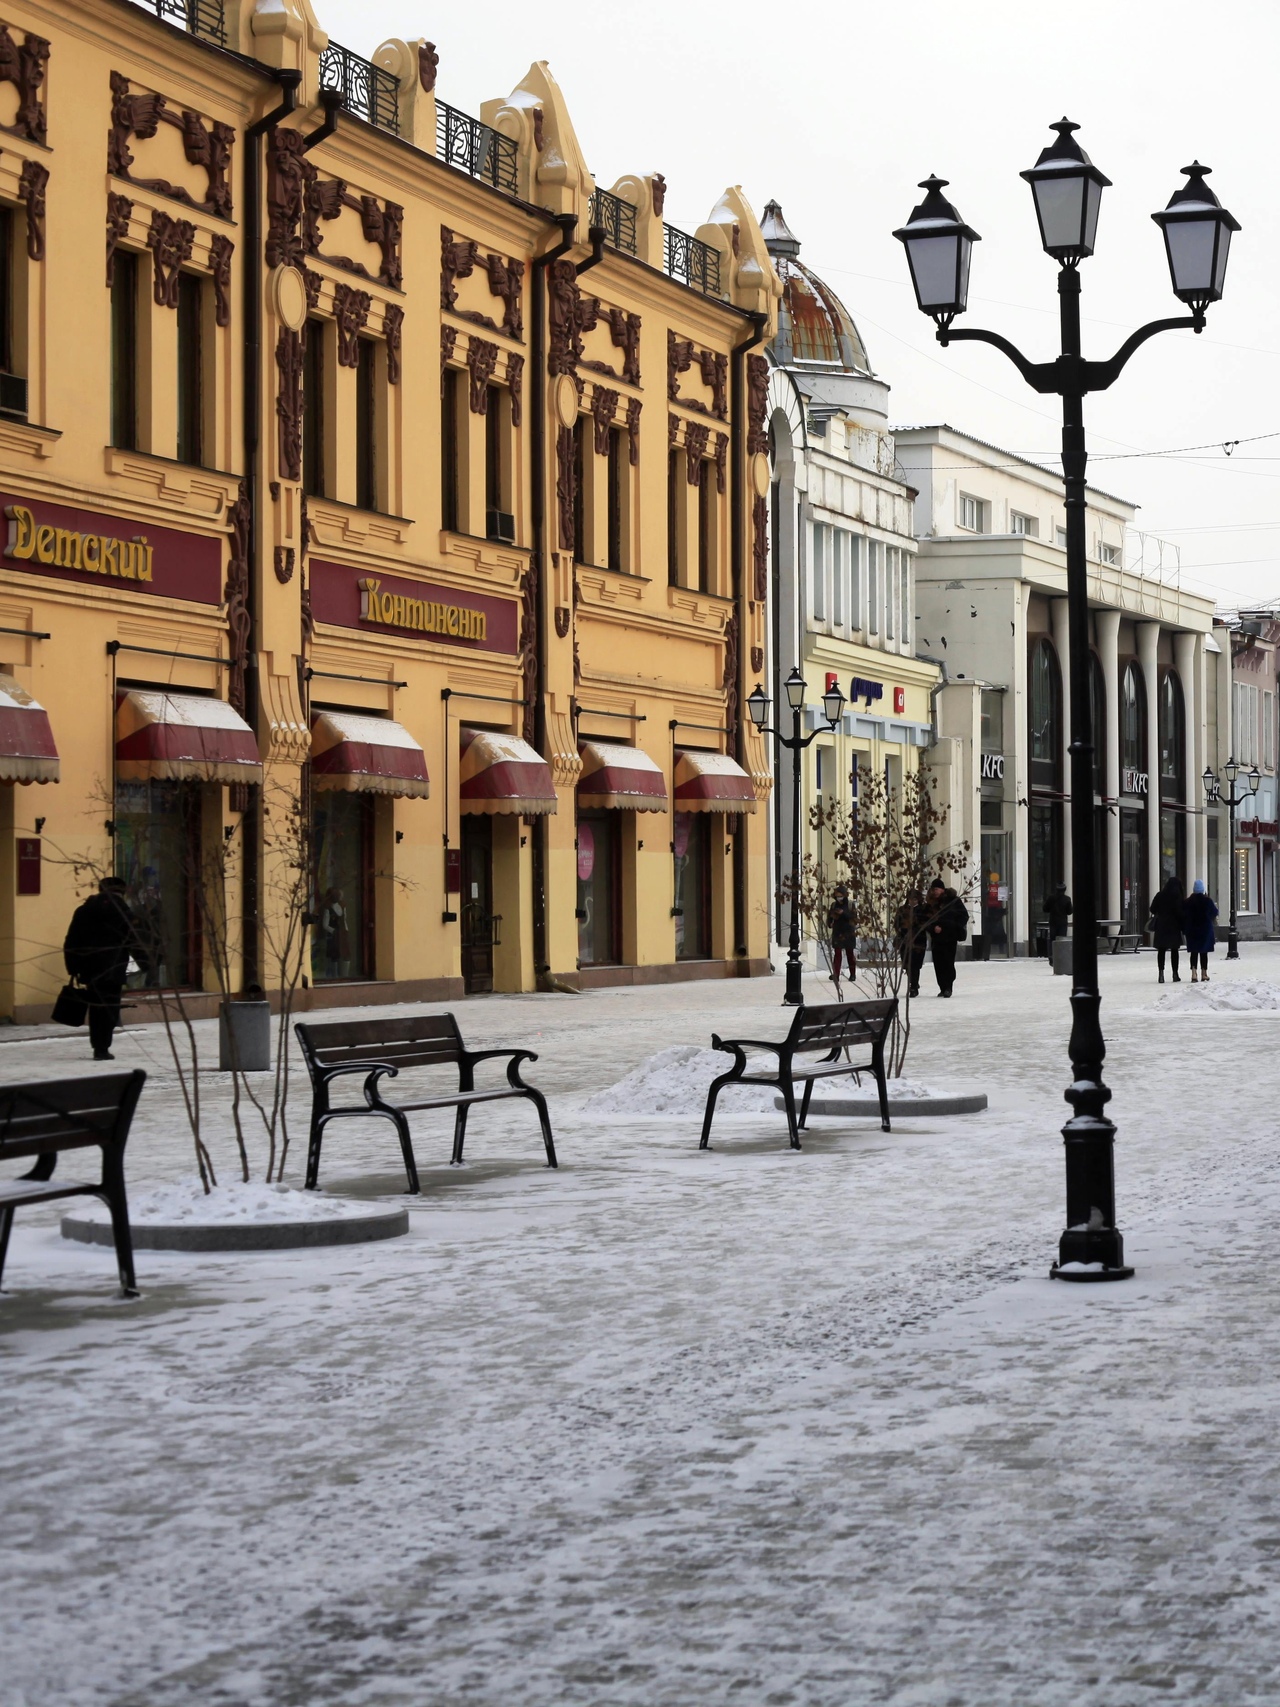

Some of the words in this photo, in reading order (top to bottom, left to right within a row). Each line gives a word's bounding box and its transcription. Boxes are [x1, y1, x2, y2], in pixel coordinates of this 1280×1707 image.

[5, 505, 154, 582] Детский
[359, 578, 488, 641] Континент
[982, 754, 1005, 779] KFC
[1132, 772, 1149, 794] KFC
